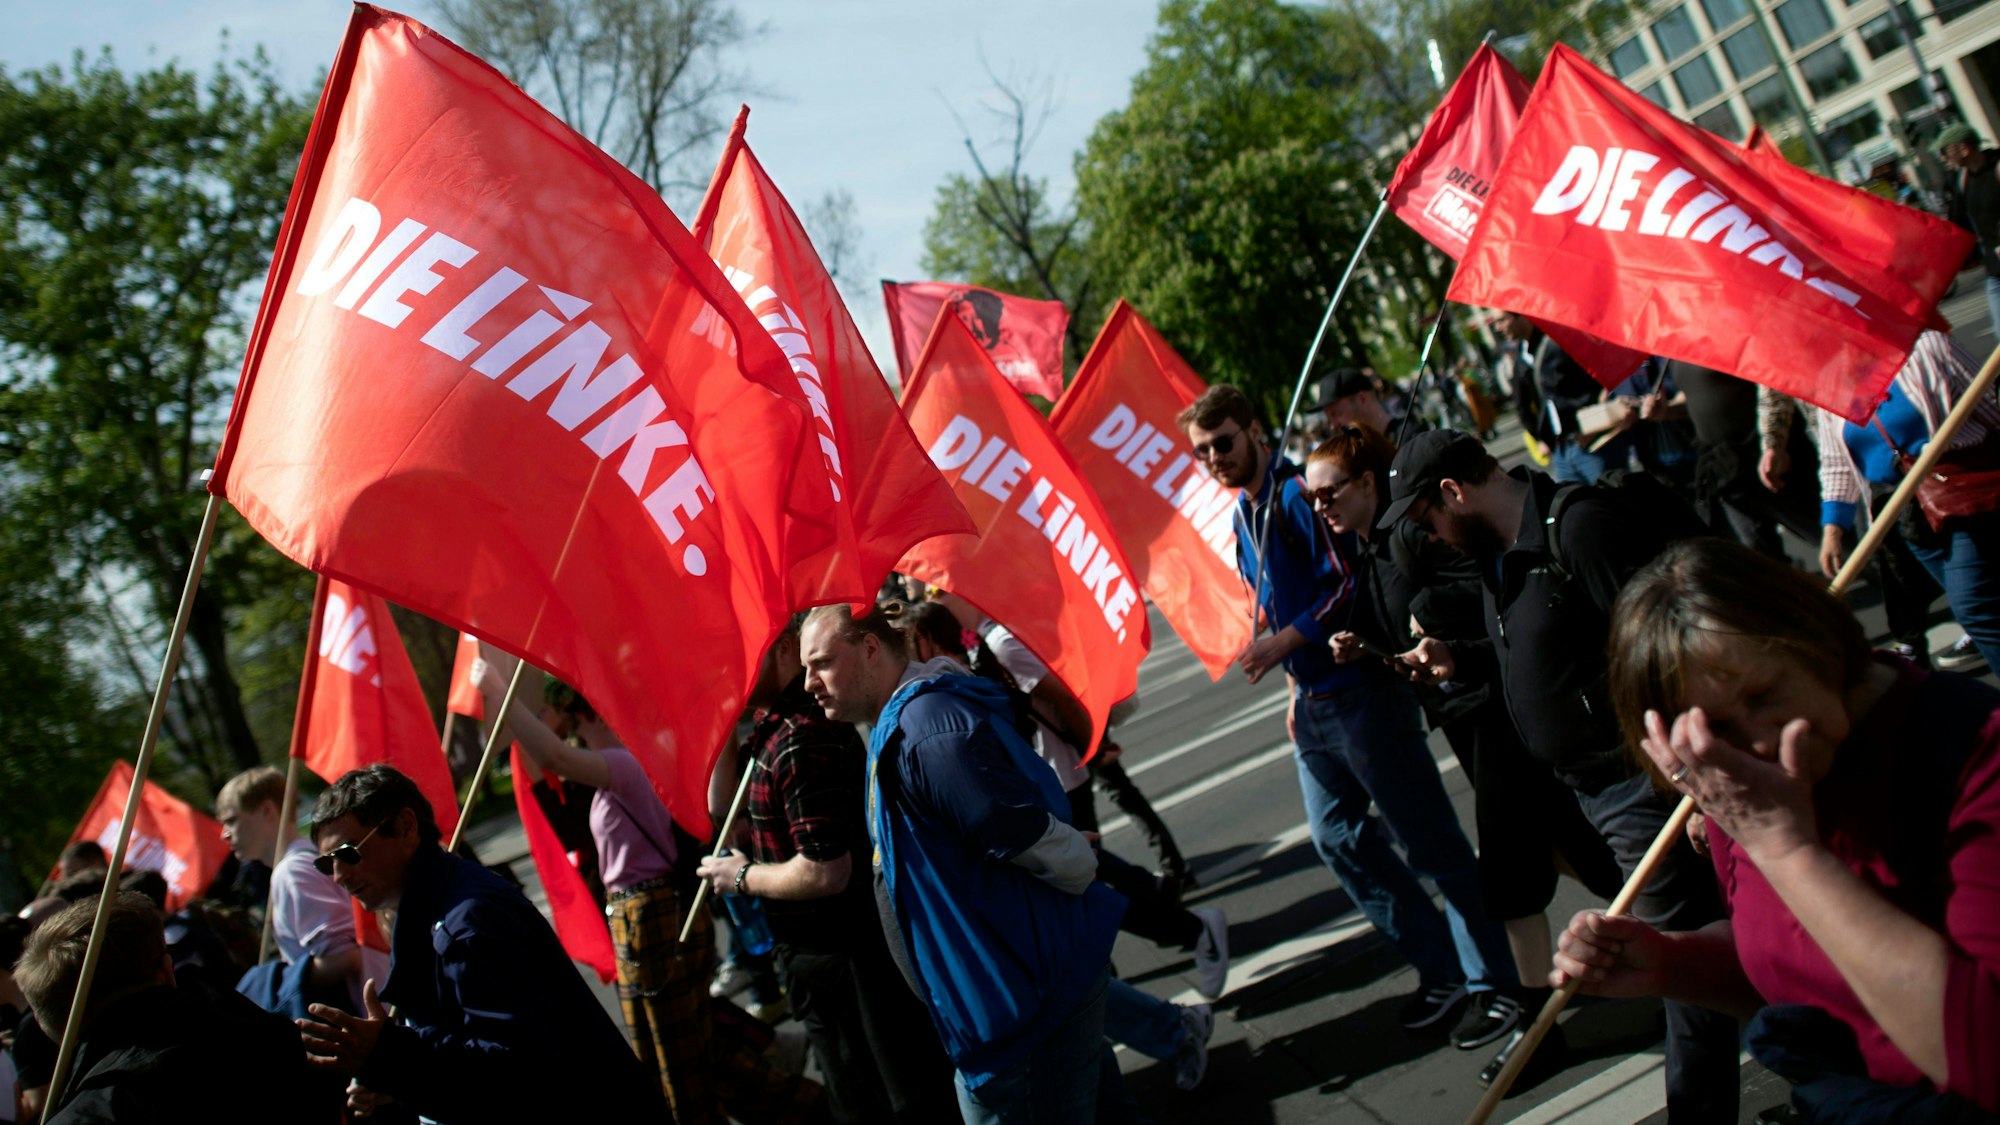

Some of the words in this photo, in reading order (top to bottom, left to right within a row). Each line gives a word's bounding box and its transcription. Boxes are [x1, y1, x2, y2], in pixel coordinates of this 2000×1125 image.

[1446, 166, 1476, 190] DIE
[1532, 146, 1661, 231] DIE
[296, 197, 480, 330] DIE
[928, 414, 1032, 503] DIE
[1088, 402, 1175, 480] DIE
